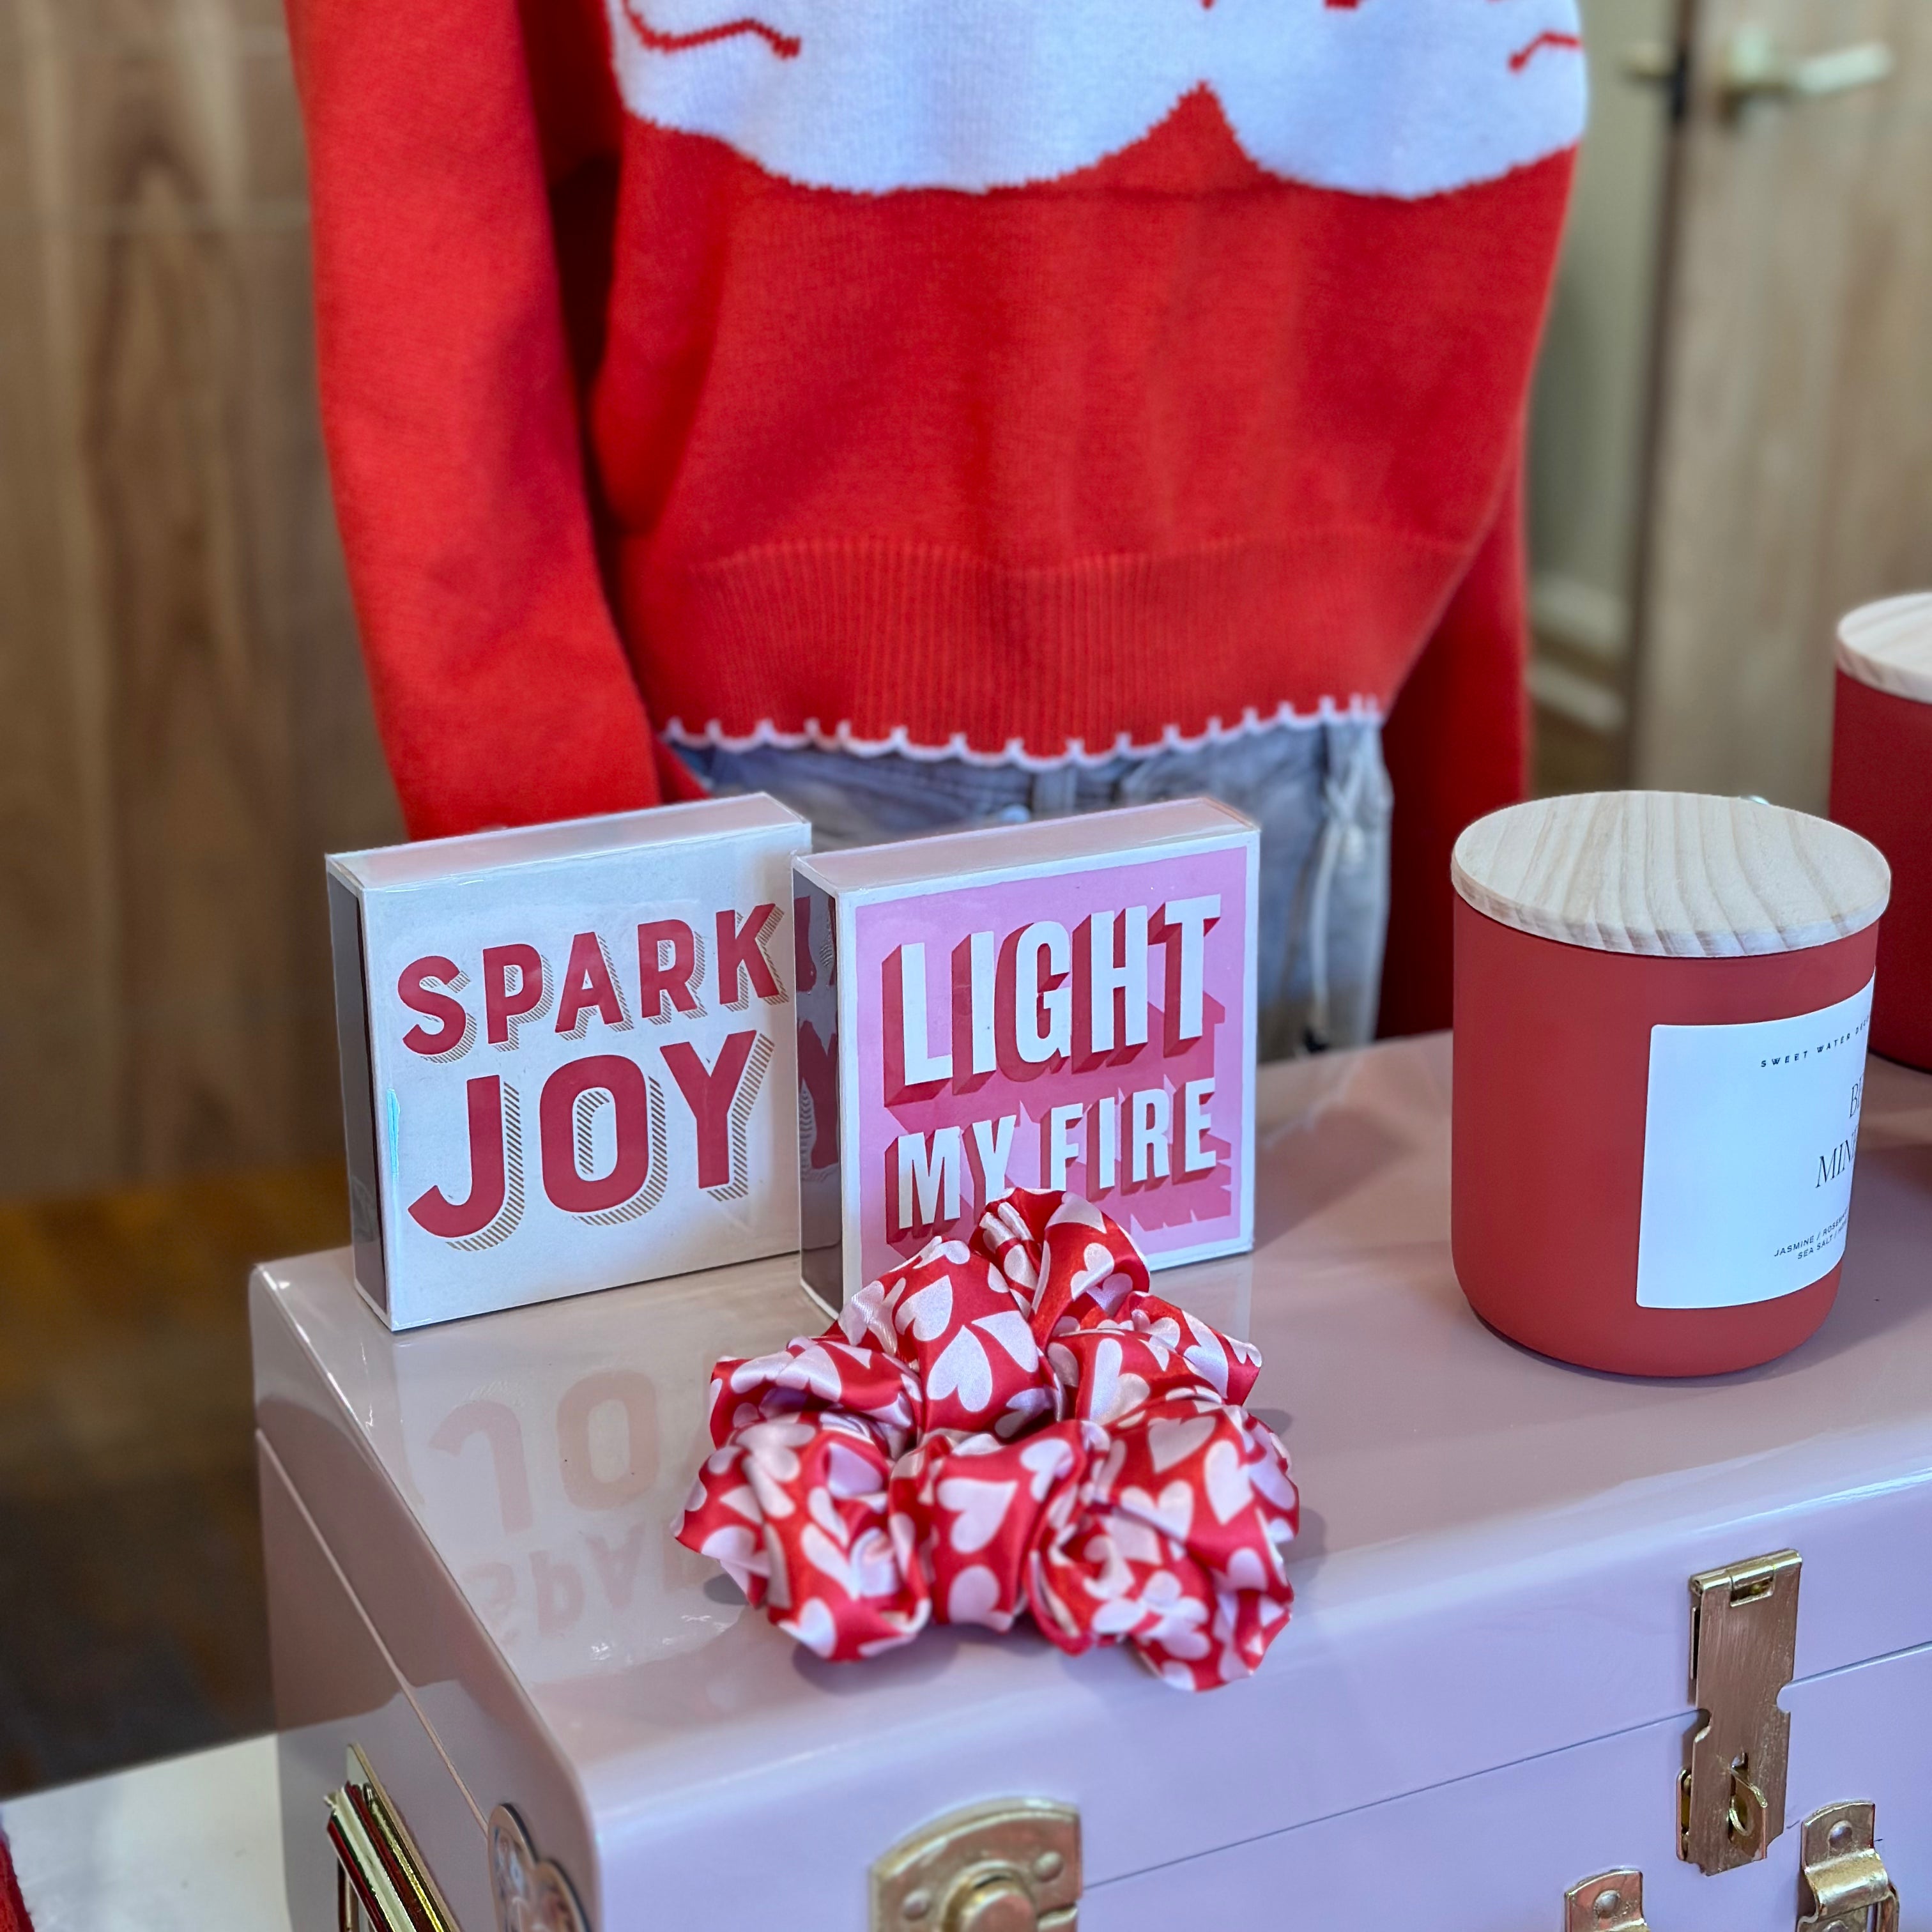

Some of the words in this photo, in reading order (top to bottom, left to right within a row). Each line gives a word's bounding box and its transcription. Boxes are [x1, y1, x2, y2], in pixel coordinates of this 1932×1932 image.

[397, 903, 788, 1061] SPARK
[882, 894, 1221, 1107] LIGHT
[1761, 1050, 1808, 1068] SWEET
[1817, 1032, 1850, 1054] WATER
[408, 1029, 774, 1251] JOY
[886, 1114, 1016, 1239] MY
[1041, 1077, 1216, 1198] FIRE
[1774, 1235, 1814, 1257] JASMINE
[1798, 1247, 1814, 1259] SEA
[1816, 1234, 1832, 1250] SALT
